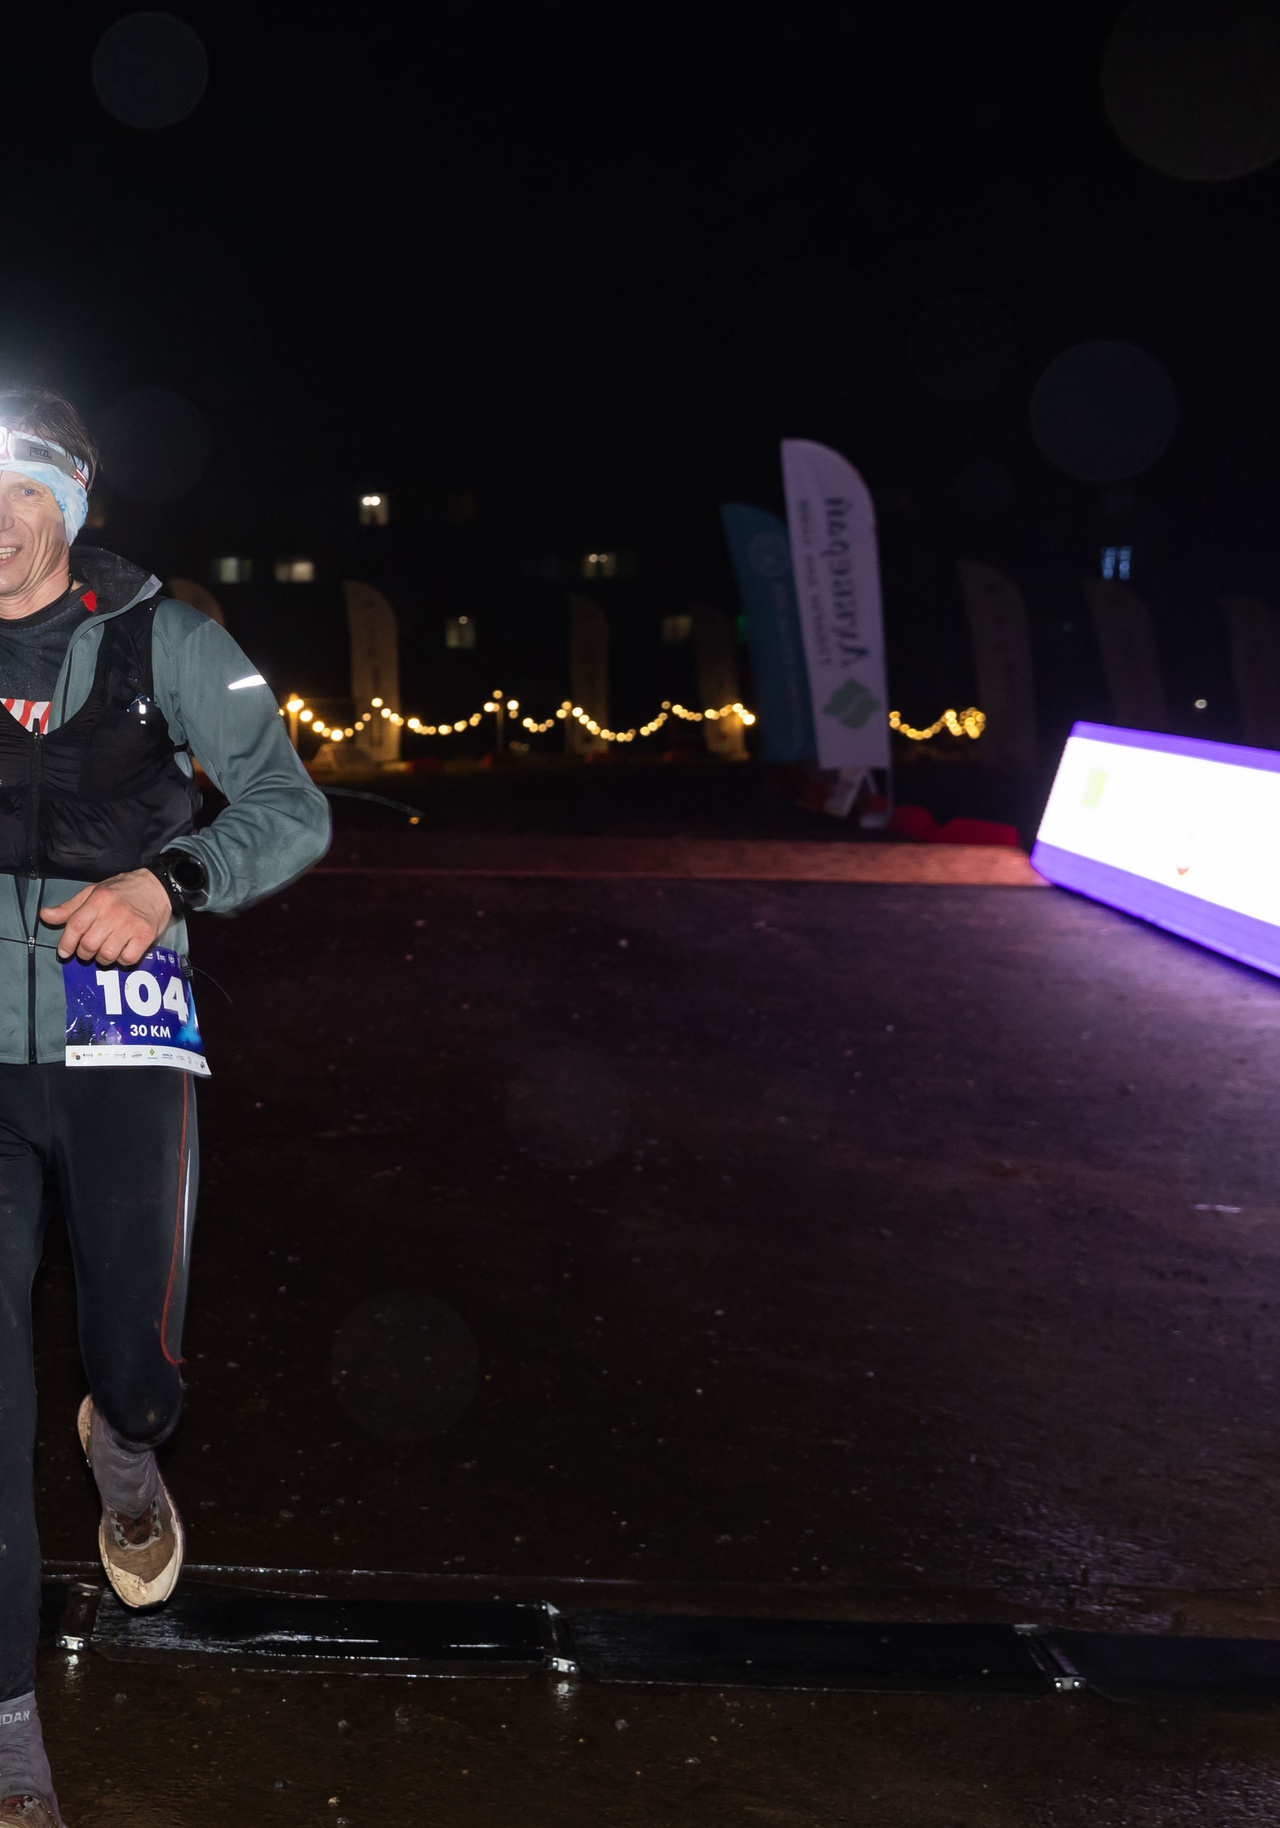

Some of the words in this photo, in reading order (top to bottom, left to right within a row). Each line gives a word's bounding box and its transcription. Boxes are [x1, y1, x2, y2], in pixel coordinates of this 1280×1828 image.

[30, 446, 52, 459] PETZL
[95, 970, 189, 1022] 104
[130, 1024, 148, 1037] 30
